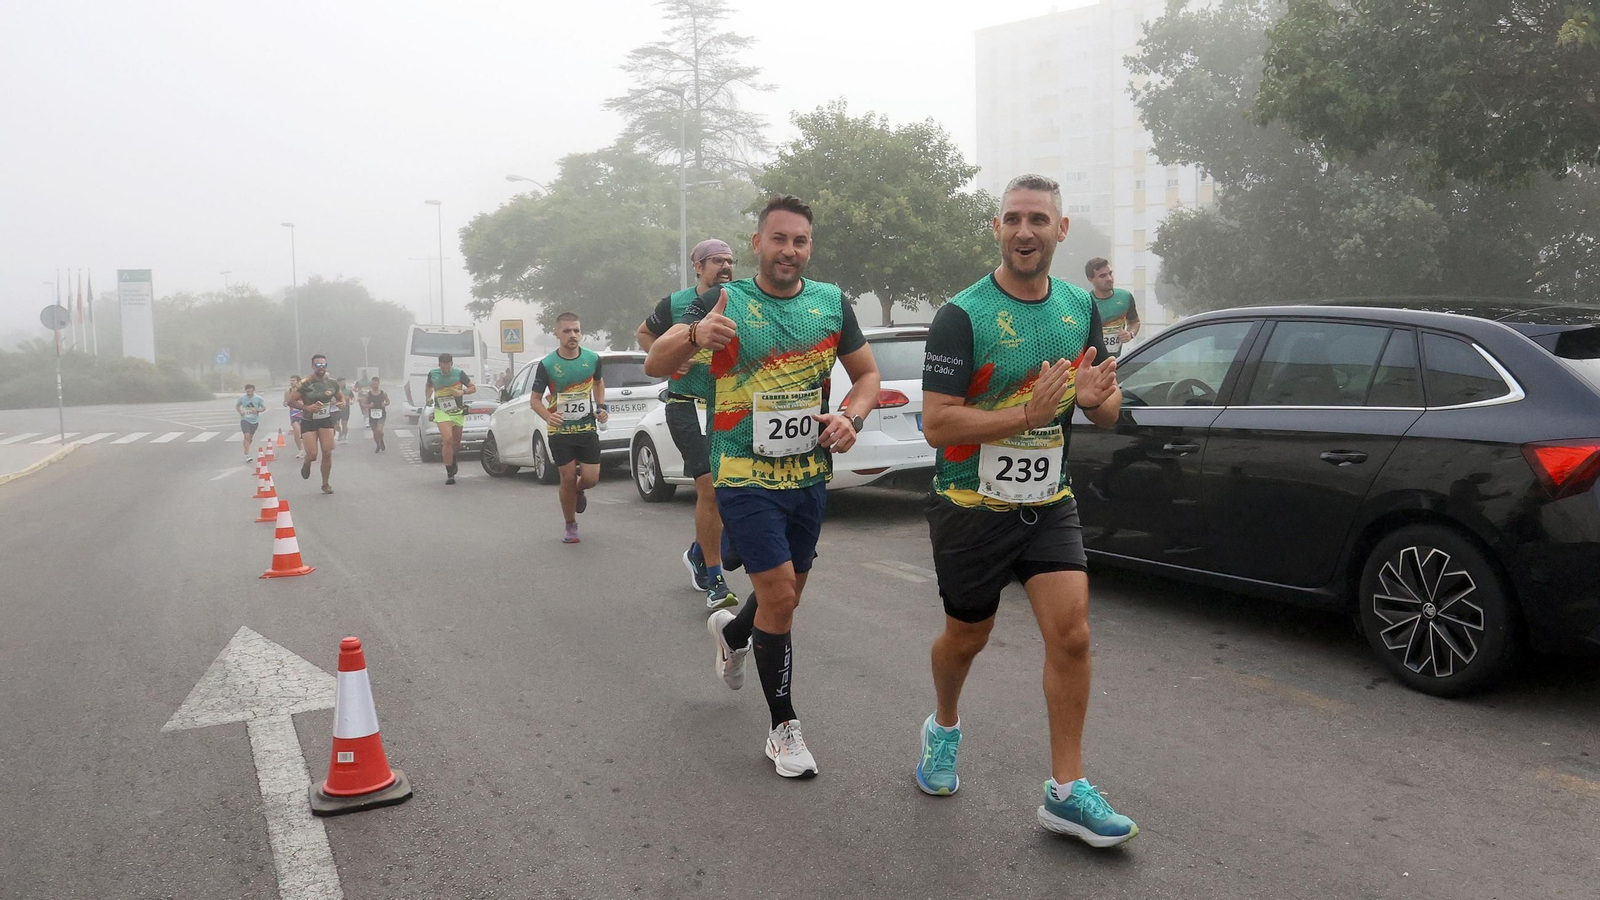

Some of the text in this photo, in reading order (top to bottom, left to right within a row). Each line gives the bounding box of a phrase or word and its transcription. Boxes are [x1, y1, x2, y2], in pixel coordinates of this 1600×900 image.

[926, 351, 964, 366] Diputación
[925, 363, 955, 376] de Cádiz
[564, 402, 585, 413] 126
[610, 403, 647, 413] 8545 KGP
[768, 415, 812, 440] 260
[995, 456, 1049, 483] 239
